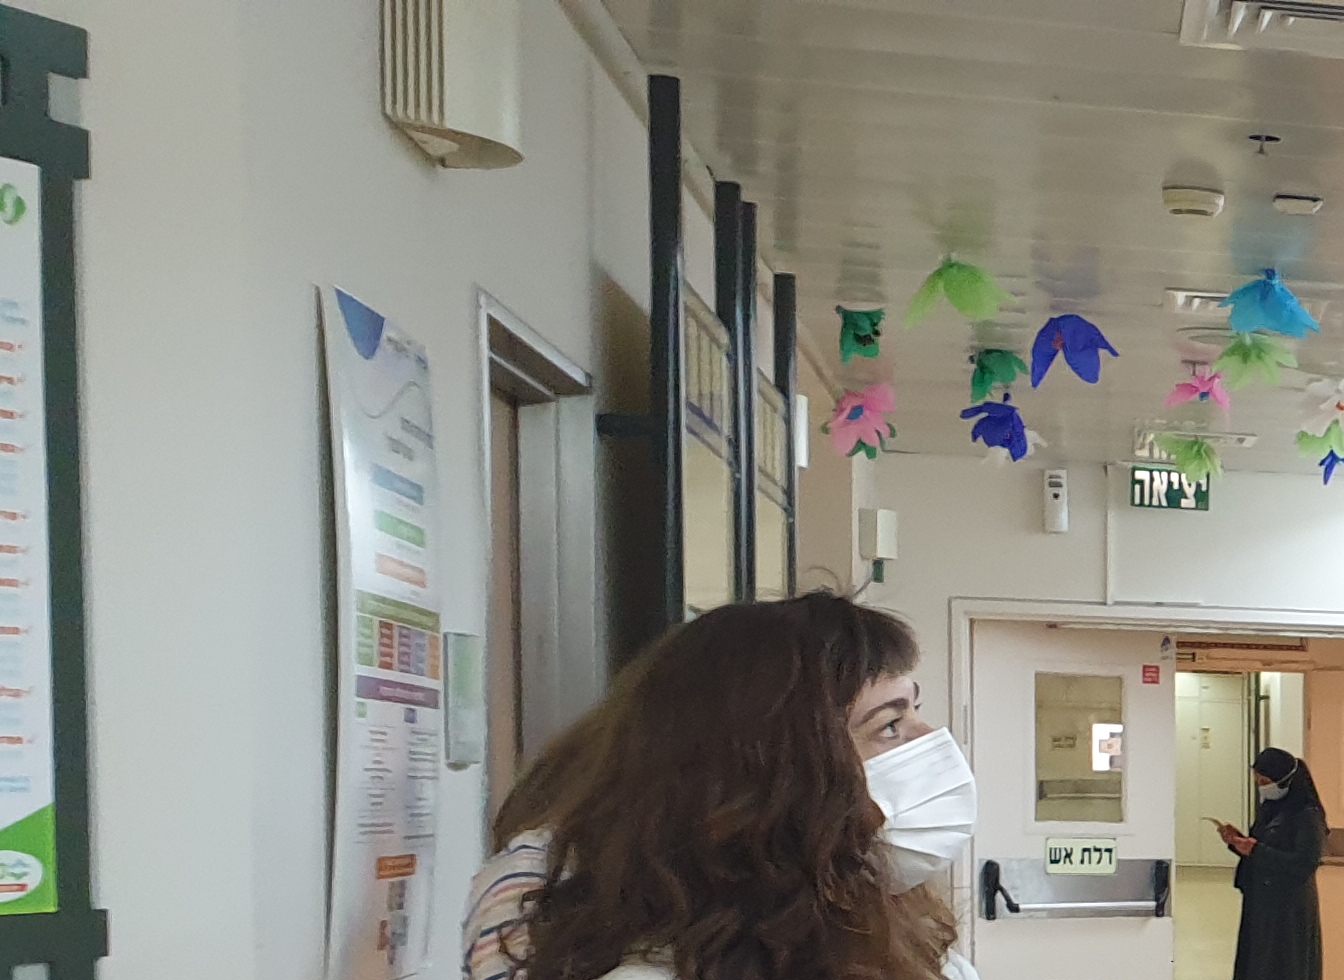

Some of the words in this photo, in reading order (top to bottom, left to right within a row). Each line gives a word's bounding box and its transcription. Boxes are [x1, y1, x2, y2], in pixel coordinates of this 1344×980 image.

[1133, 469, 1208, 509] יציאה
[1048, 847, 1074, 865] אש
[1079, 845, 1113, 865] דלת
